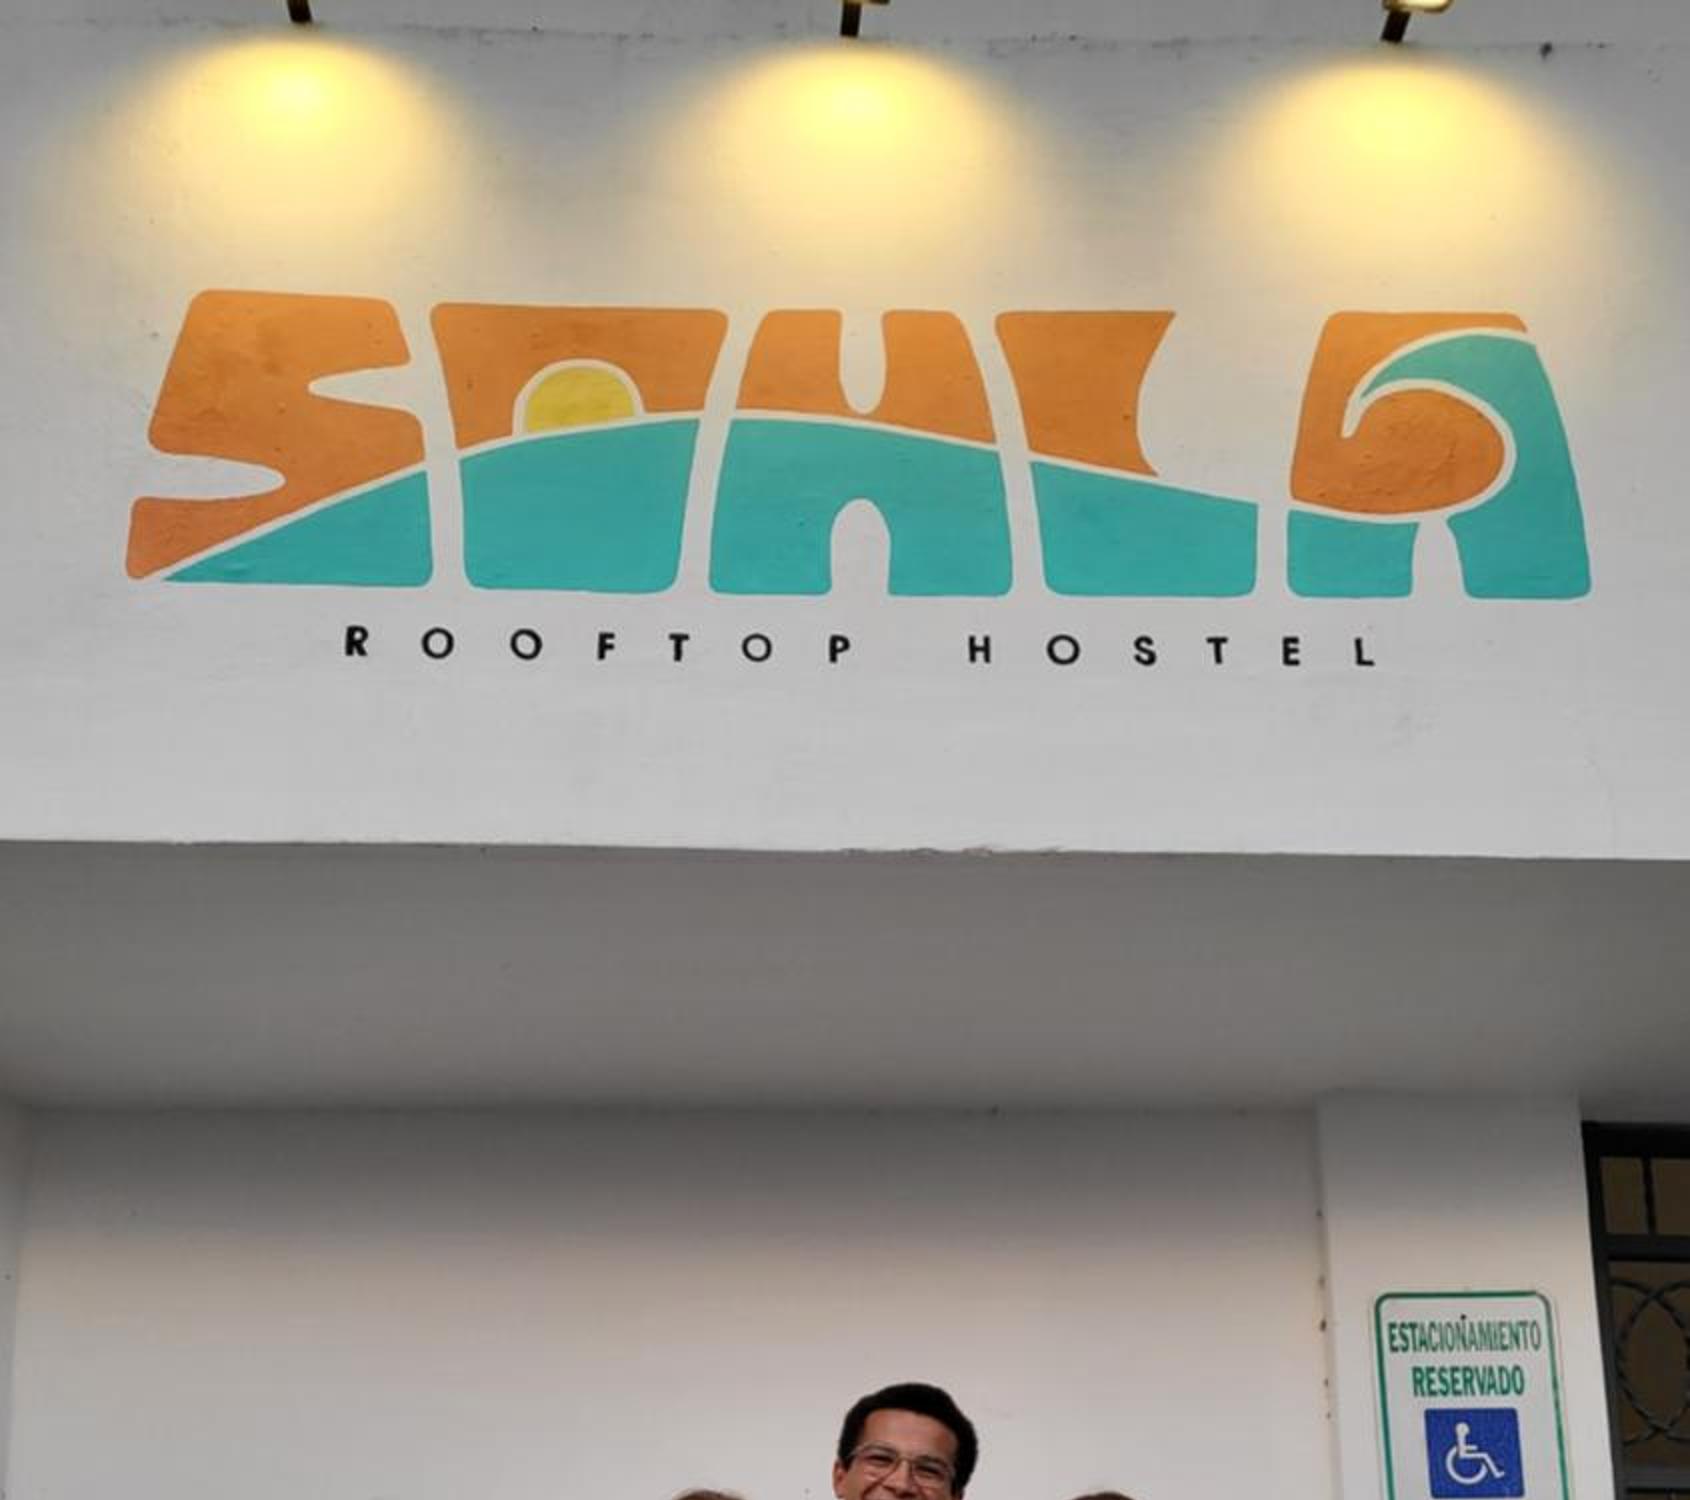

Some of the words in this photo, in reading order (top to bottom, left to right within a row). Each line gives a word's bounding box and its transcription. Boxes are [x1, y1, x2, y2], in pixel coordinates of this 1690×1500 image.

[344, 624, 852, 667] ROOFTOP
[967, 633, 1376, 668] HOSTEL
[1387, 1319, 1542, 1353] ESTACIONAMIENTO
[1411, 1364, 1525, 1397] RESERVADO
